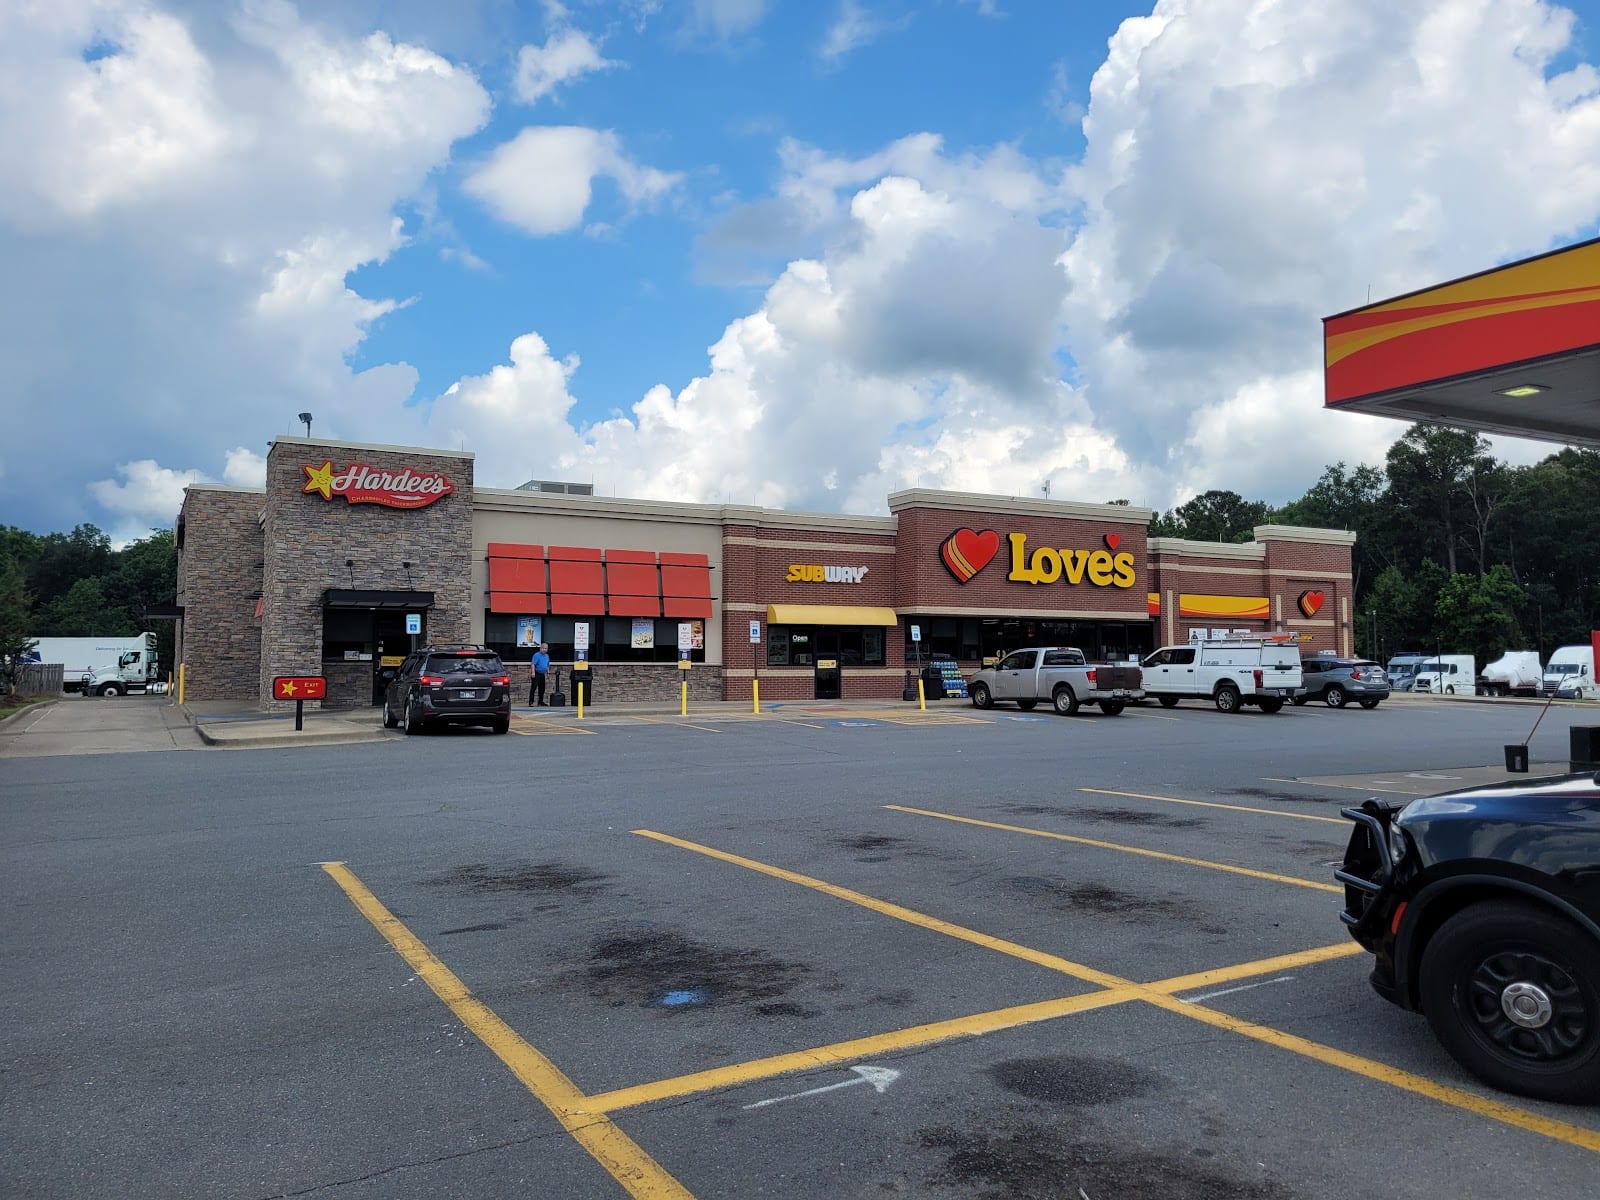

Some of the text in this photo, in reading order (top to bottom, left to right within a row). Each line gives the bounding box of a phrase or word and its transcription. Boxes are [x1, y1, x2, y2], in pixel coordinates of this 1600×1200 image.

[331, 466, 451, 493] Hardee's
[785, 565, 869, 583] SUBWAY
[792, 634, 809, 642] Open
